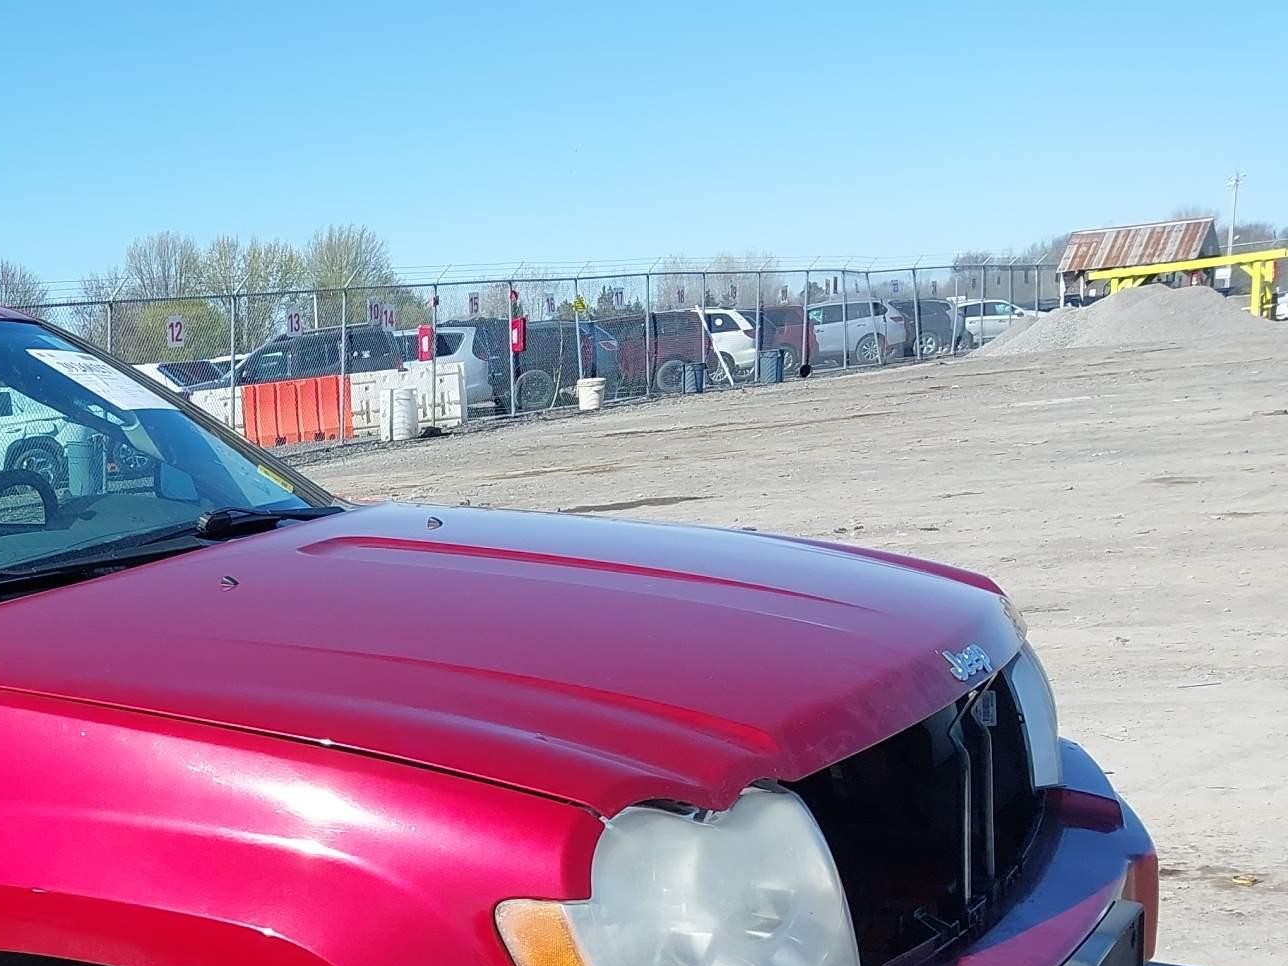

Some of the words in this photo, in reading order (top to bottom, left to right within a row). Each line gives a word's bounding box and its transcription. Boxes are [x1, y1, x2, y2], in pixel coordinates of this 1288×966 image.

[469, 295, 479, 314] 15
[614, 291, 624, 306] 17
[288, 313, 300, 332] 13
[383, 309, 394, 328] 14
[168, 321, 183, 342] 12
[941, 644, 992, 681] Jeep
